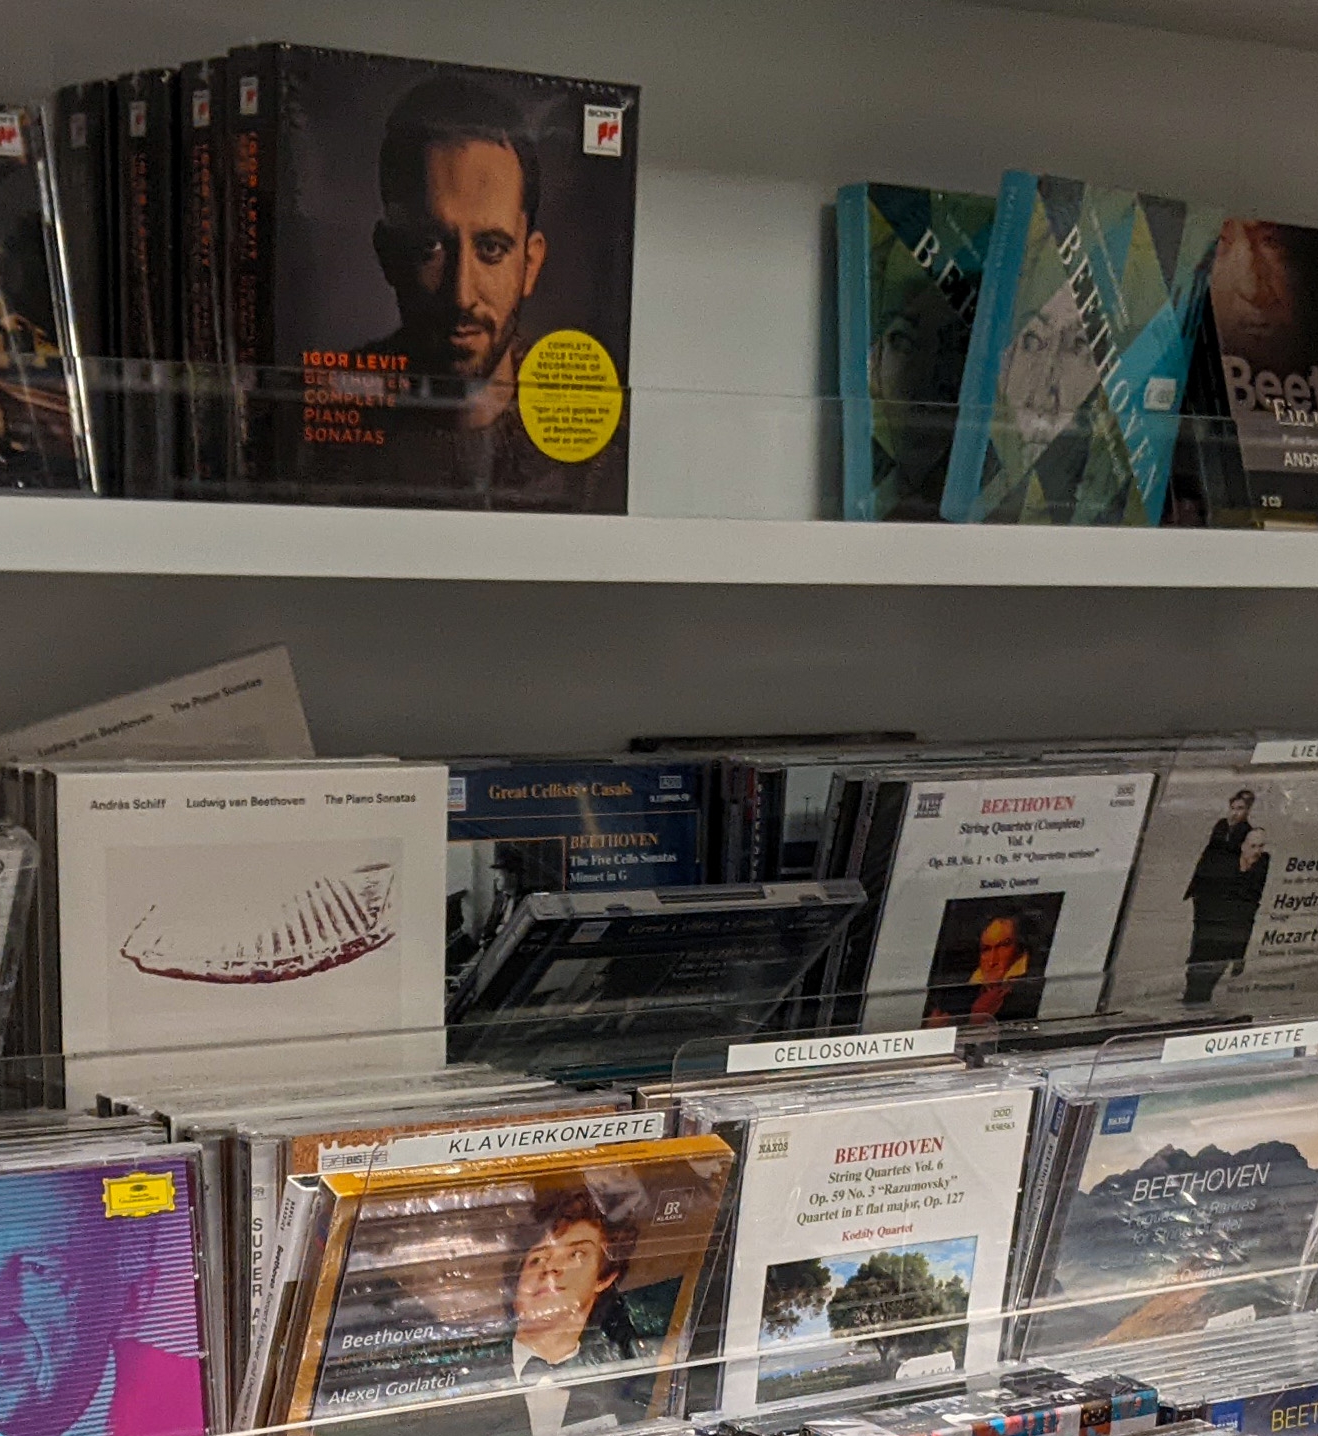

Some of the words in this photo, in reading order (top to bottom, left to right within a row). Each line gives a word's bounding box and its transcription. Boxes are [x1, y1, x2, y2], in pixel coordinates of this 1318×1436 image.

[302, 352, 349, 368] IGOR
[357, 353, 408, 371] LEVIT
[303, 408, 360, 425] PIANO
[304, 427, 385, 445] SONATAS
[488, 784, 528, 800] Great
[532, 783, 578, 798] Cellists
[591, 781, 633, 798] Casals
[981, 796, 1075, 815] BEETHOVEN
[570, 833, 659, 849] BEETHOVEN
[1261, 929, 1318, 946] Mozart
[774, 1036, 915, 1065] CELLOSONATEN
[1204, 1028, 1305, 1053] QUARTETTE
[448, 1117, 656, 1155] KLAVIERKONZERTE
[834, 1136, 944, 1164] BEETHOVEN
[828, 1170, 862, 1184] String
[864, 1165, 911, 1180] Quartets
[915, 1161, 934, 1171] Vol.
[936, 1159, 943, 1169] 6
[1132, 1162, 1270, 1203] BEETHOVEN
[341, 1325, 434, 1350] Beethoven
[328, 1386, 380, 1404] Alexej
[385, 1373, 456, 1397] Gorlatch
